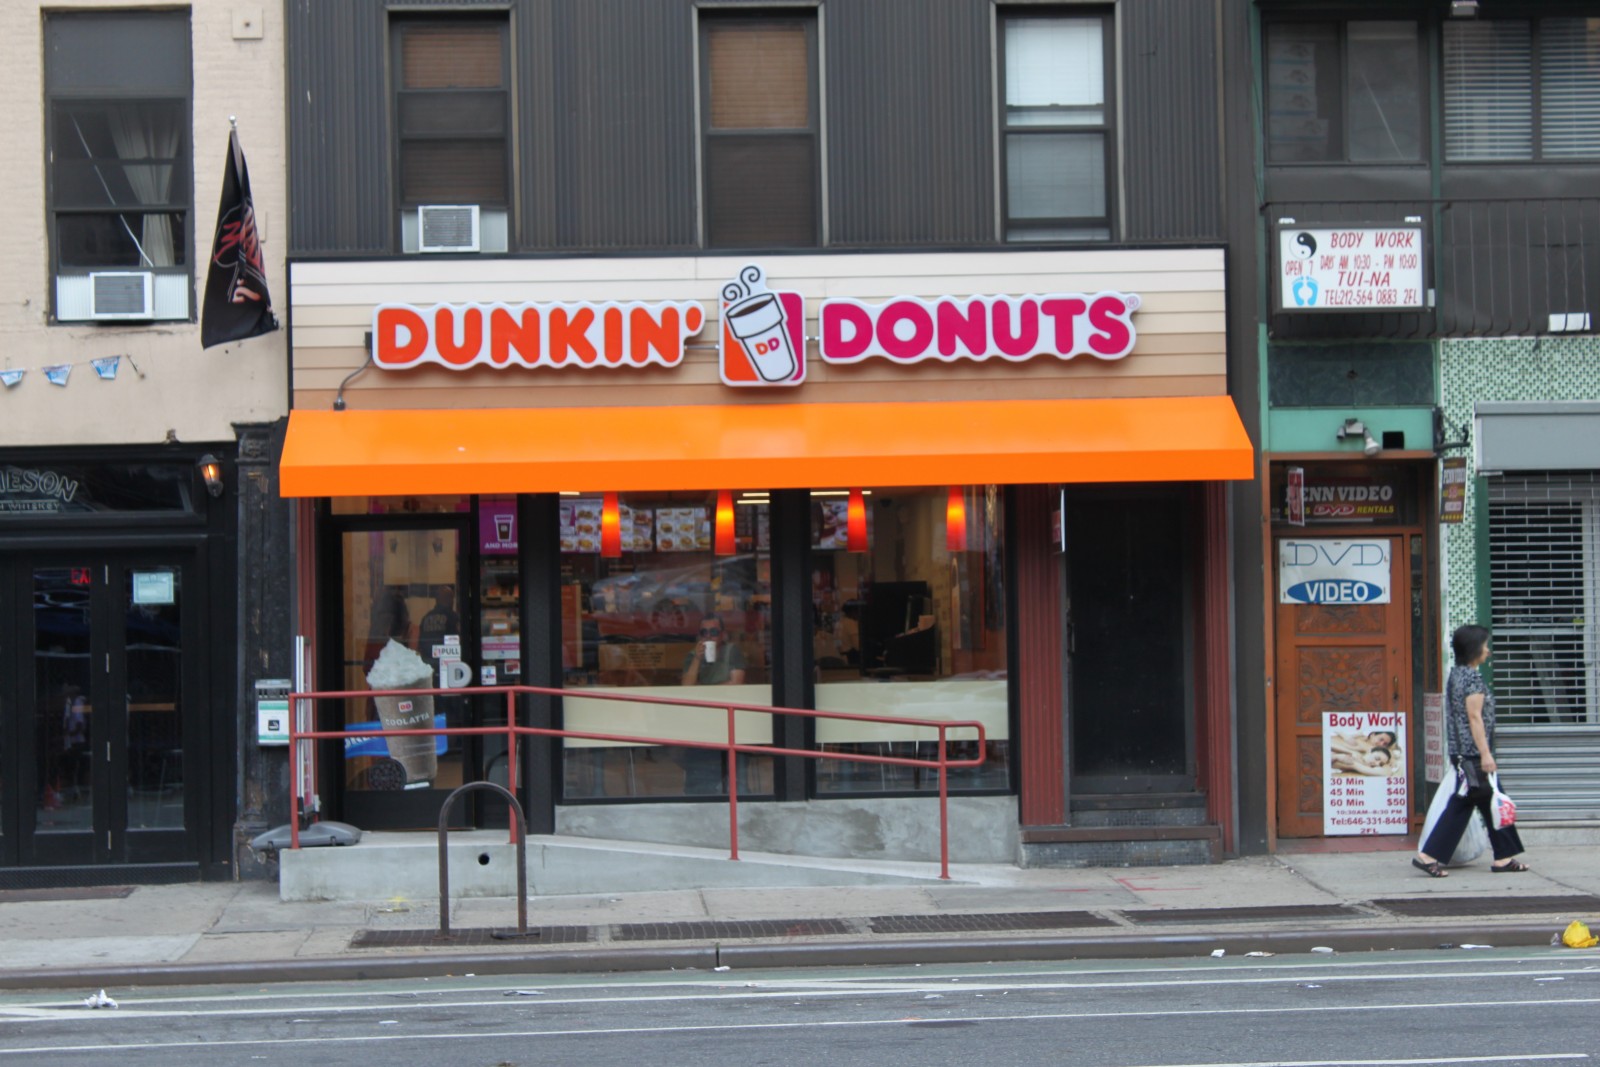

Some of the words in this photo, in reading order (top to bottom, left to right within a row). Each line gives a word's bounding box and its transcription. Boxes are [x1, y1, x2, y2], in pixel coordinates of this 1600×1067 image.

[1331, 232, 1363, 248] BODY
[1375, 231, 1413, 248] WORK
[1285, 260, 1303, 275] OPEN
[1309, 260, 1314, 275] 7
[1339, 255, 1349, 270] AM
[1354, 254, 1371, 269] 10:30
[1384, 254, 1394, 268] PM
[1399, 254, 1417, 269] 10:00
[1338, 271, 1390, 287] TUI-NA
[1376, 288, 1398, 305] 0883
[1403, 288, 1417, 304] 2FL
[377, 307, 701, 365] DUNKIN'
[822, 296, 1126, 359] DONUTS
[755, 337, 780, 356] DD
[1336, 485, 1392, 501] VIDEO
[1357, 506, 1394, 514] RENTALS
[1286, 543, 1384, 567] DVD
[1305, 582, 1369, 603] VIDEO
[442, 648, 459, 656] PULL
[385, 713, 430, 727] COOLATTA
[1329, 713, 1363, 730] Body
[1367, 712, 1403, 727] Work
[1330, 778, 1343, 786] 30
[1346, 778, 1365, 786] Min
[1386, 777, 1406, 786] $30
[1330, 788, 1343, 796] 45
[1346, 788, 1365, 796] Min
[1386, 787, 1406, 796] $40
[1330, 799, 1343, 807] 60
[1346, 798, 1365, 807] Min
[1387, 798, 1406, 807] $50
